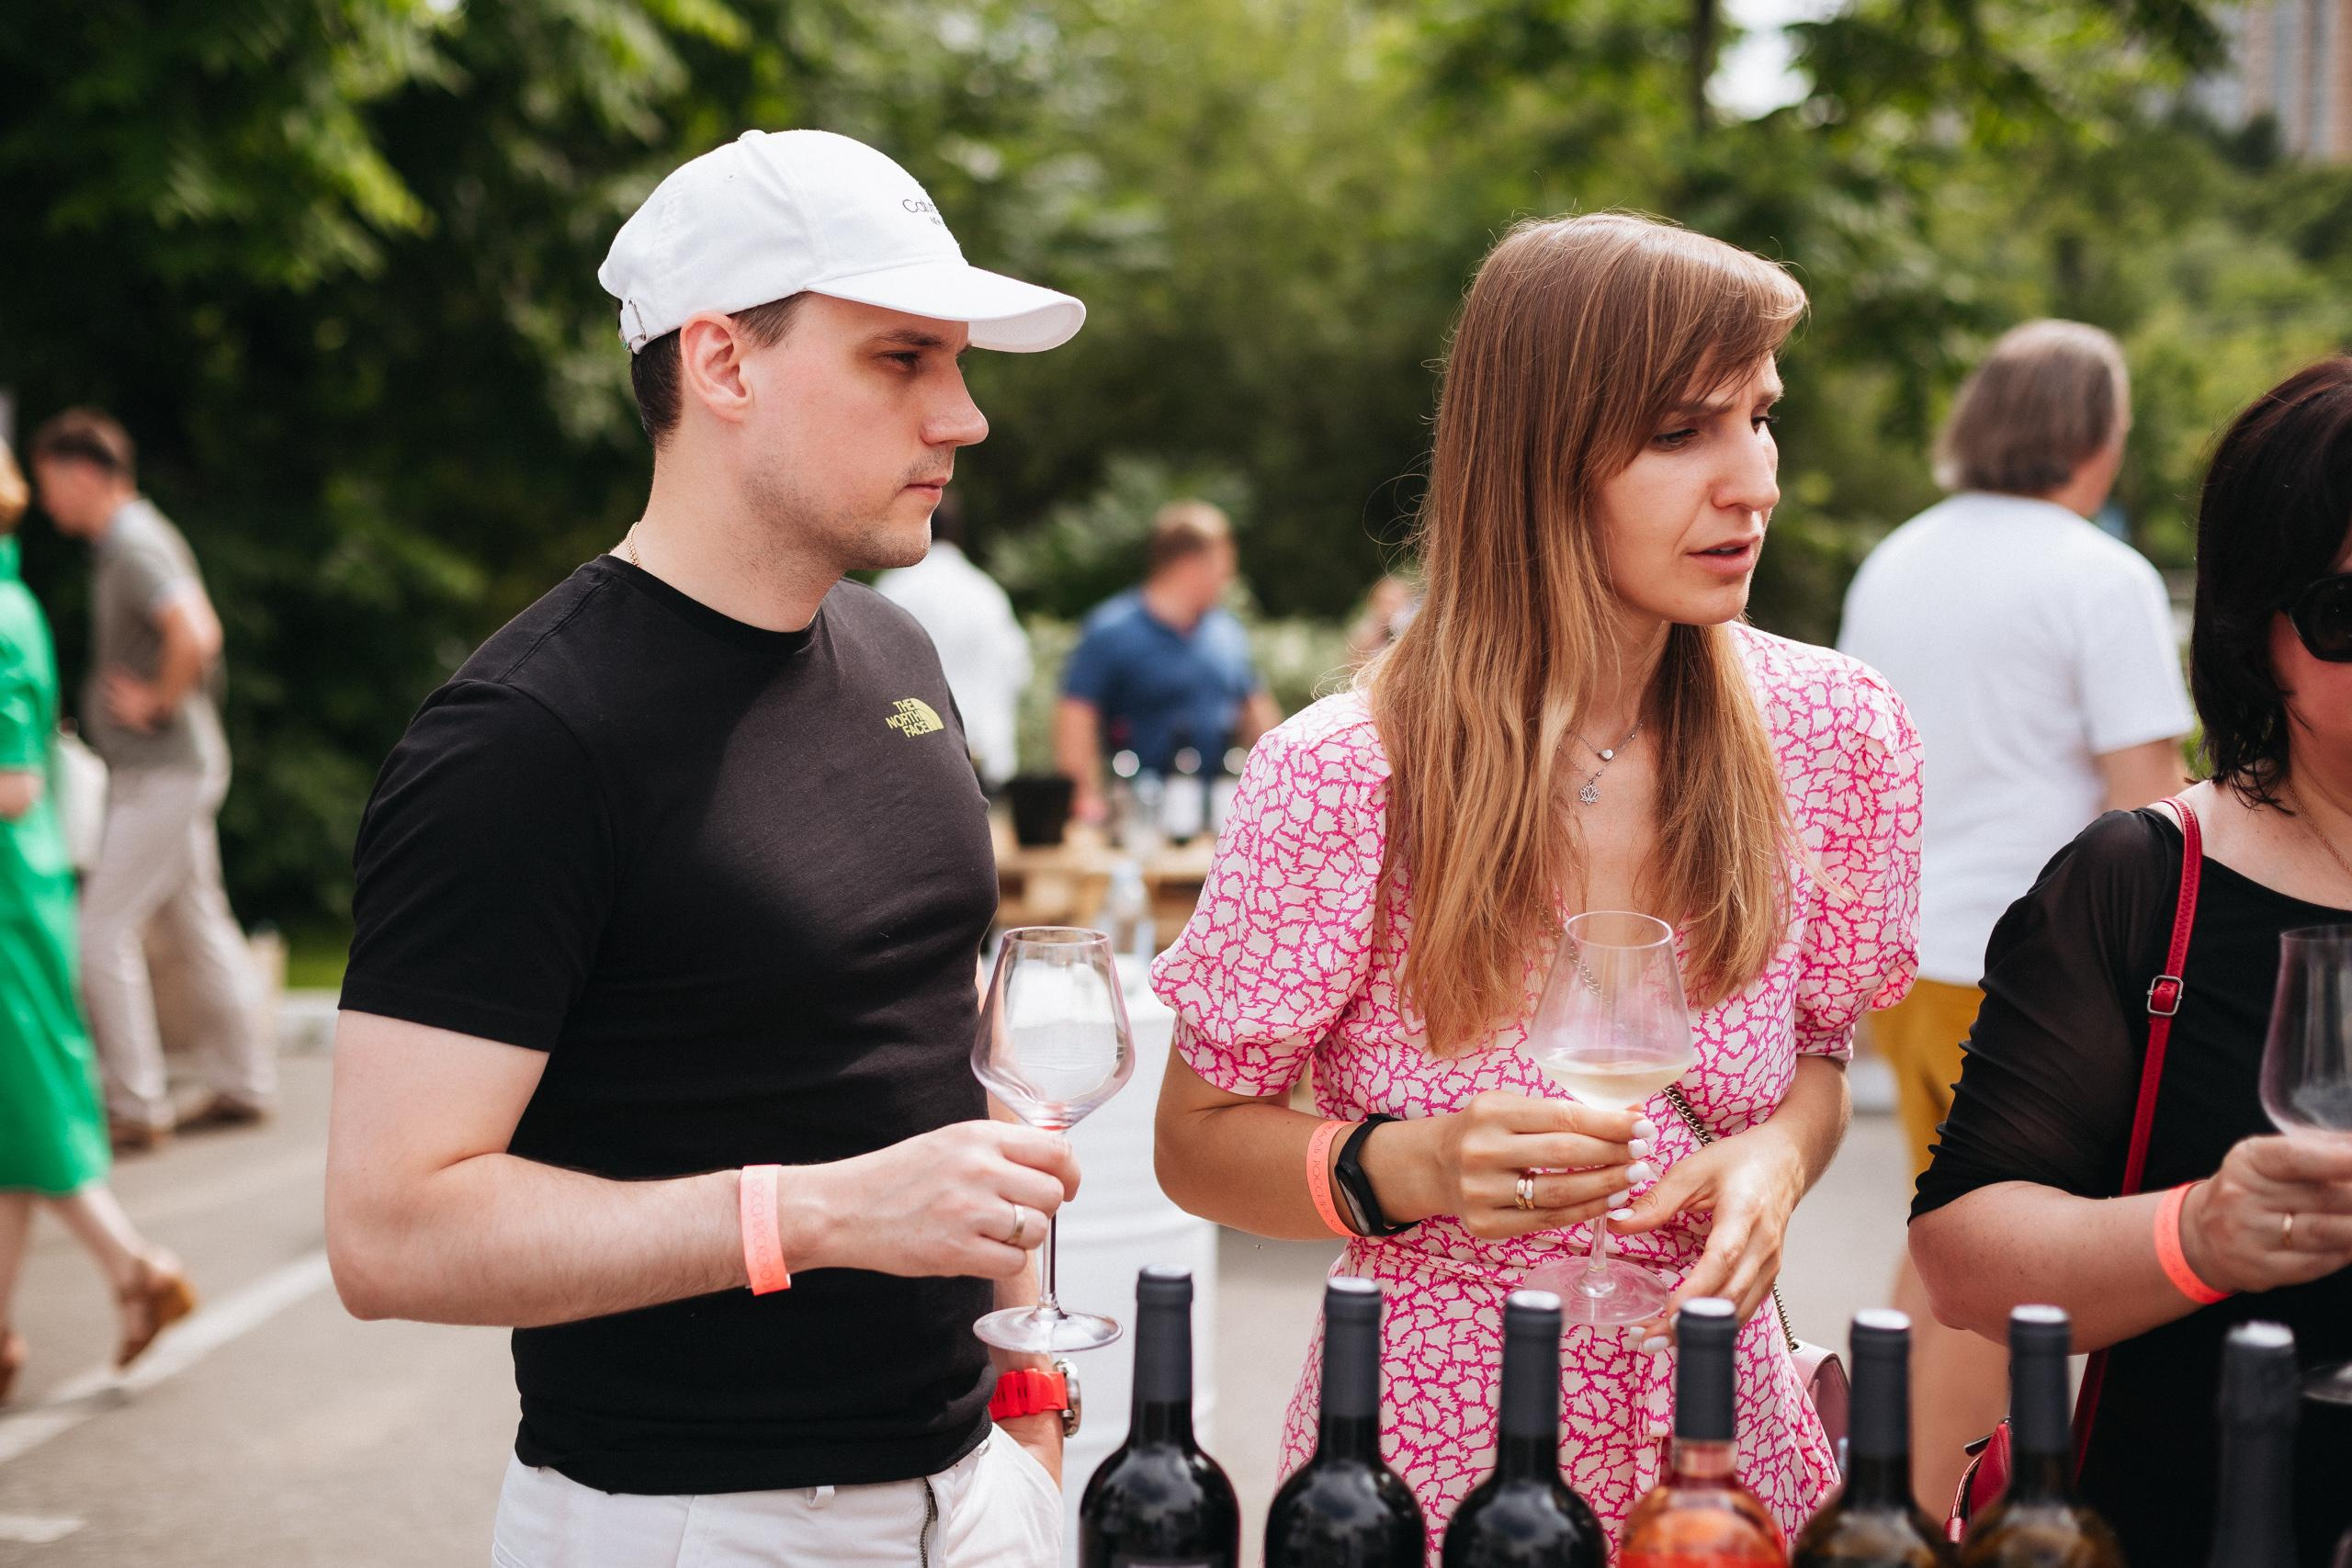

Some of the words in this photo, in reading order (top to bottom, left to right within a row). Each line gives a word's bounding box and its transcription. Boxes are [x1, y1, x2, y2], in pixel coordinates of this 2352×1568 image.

[892, 698, 915, 714] THE
[885, 709, 922, 729] NORTH
[902, 721, 931, 738] FACE
